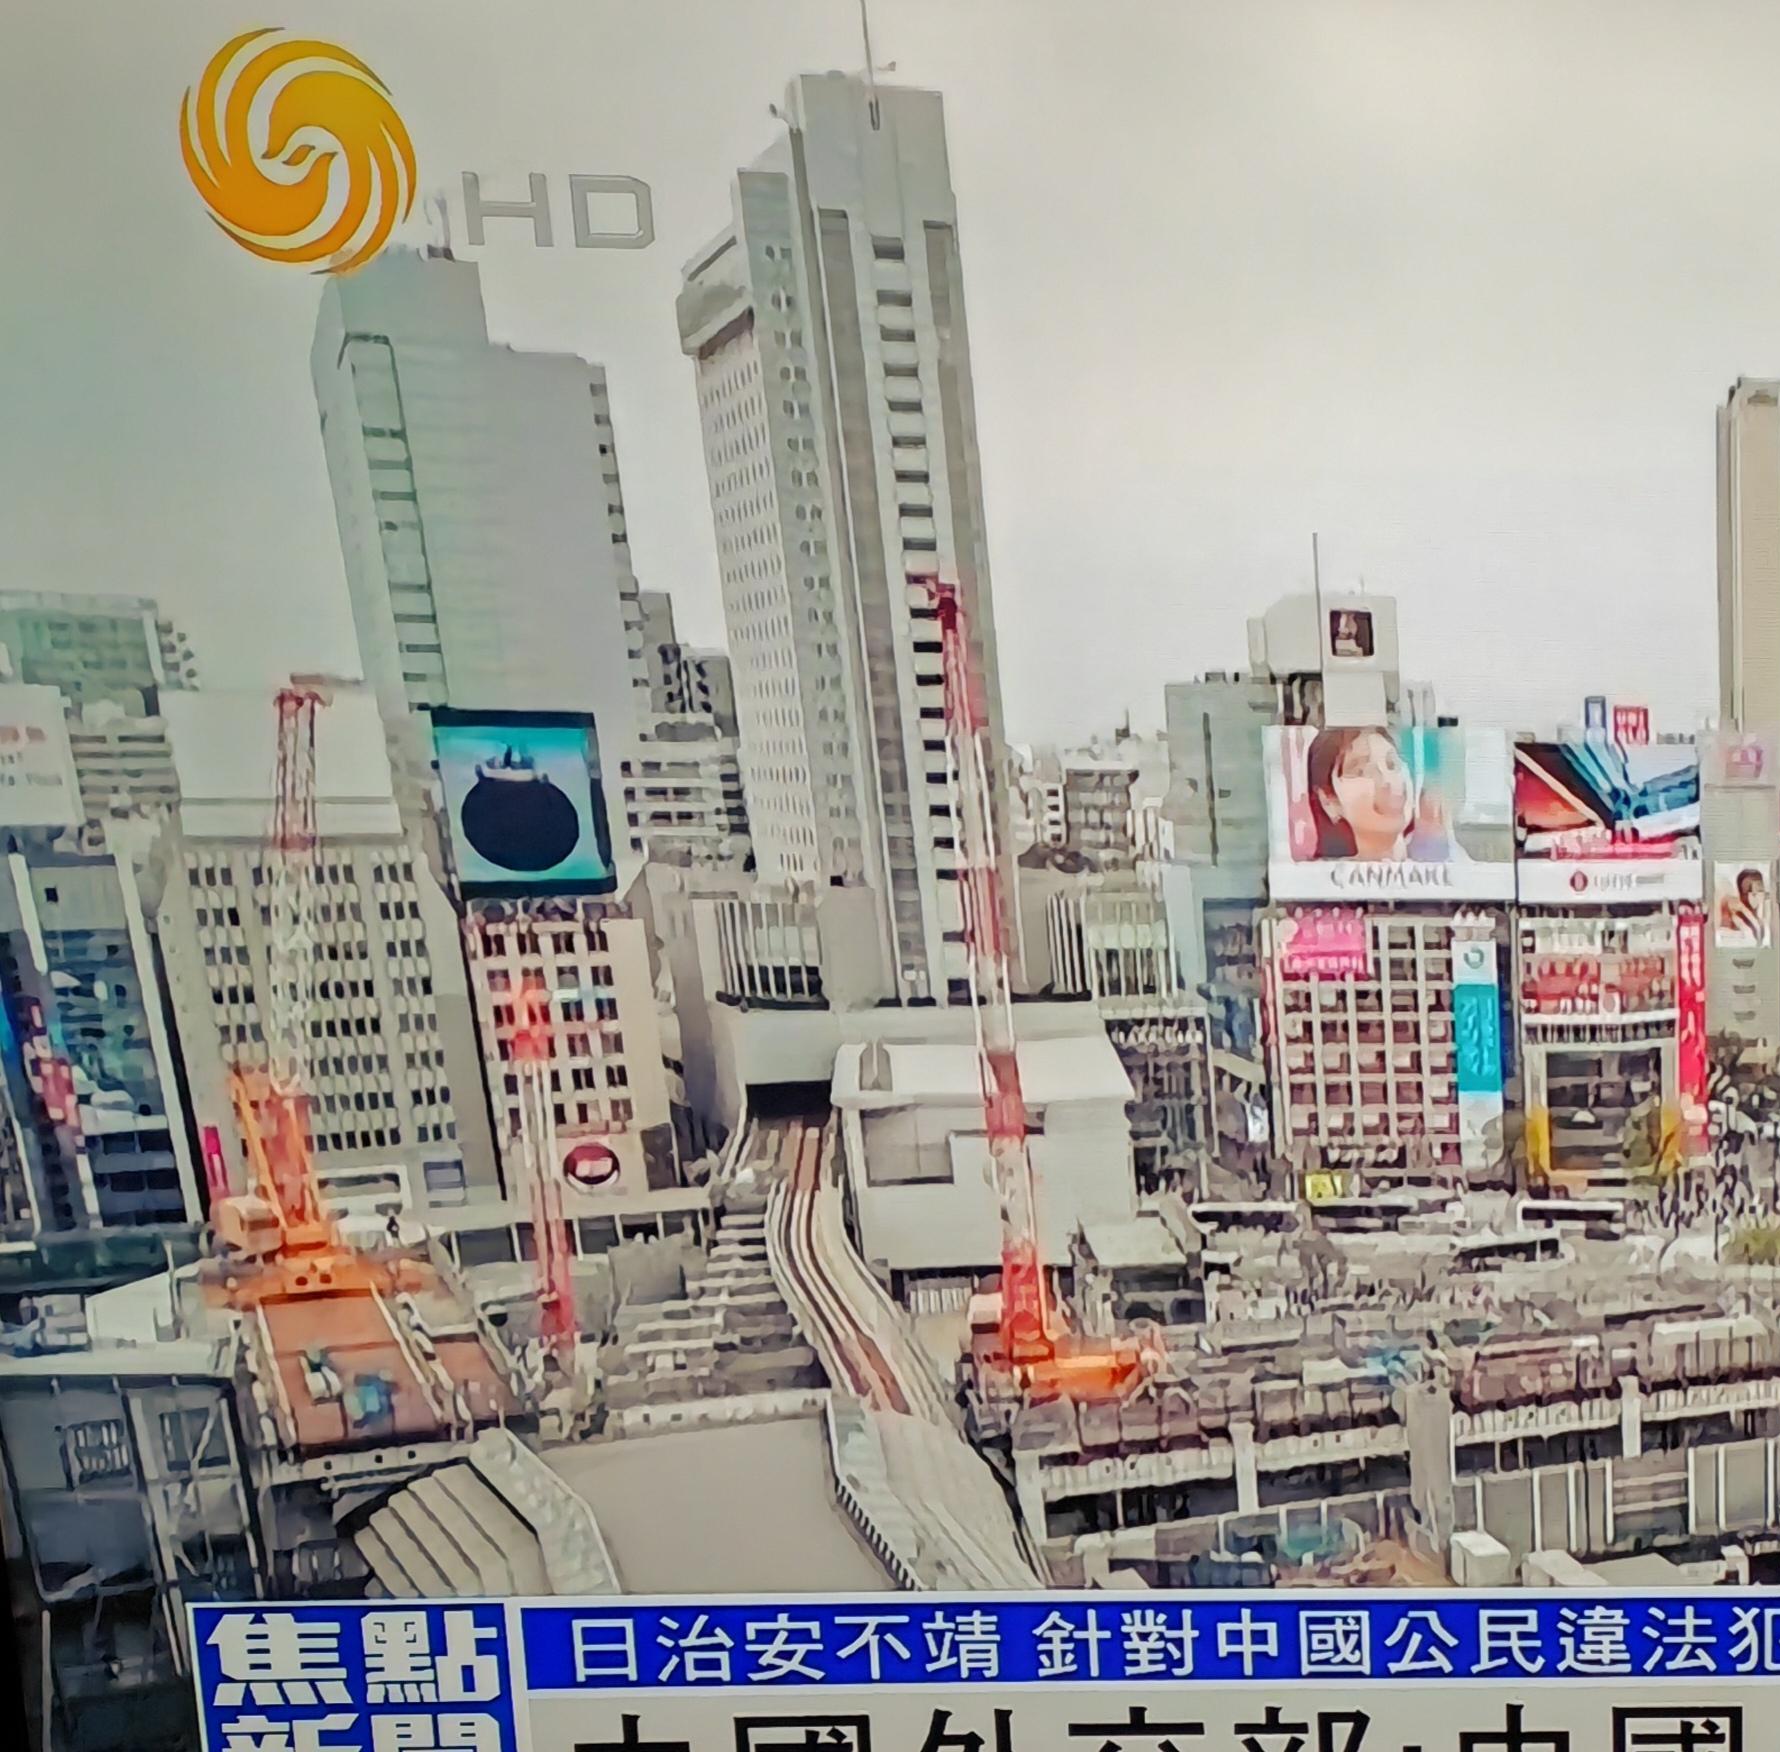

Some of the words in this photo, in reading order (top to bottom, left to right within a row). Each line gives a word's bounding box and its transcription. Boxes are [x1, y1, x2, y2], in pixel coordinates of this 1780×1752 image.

[461, 171, 655, 250] HD
[206, 1610, 501, 1706] 焦點
[571, 1610, 1001, 1682] 日治安不靖
